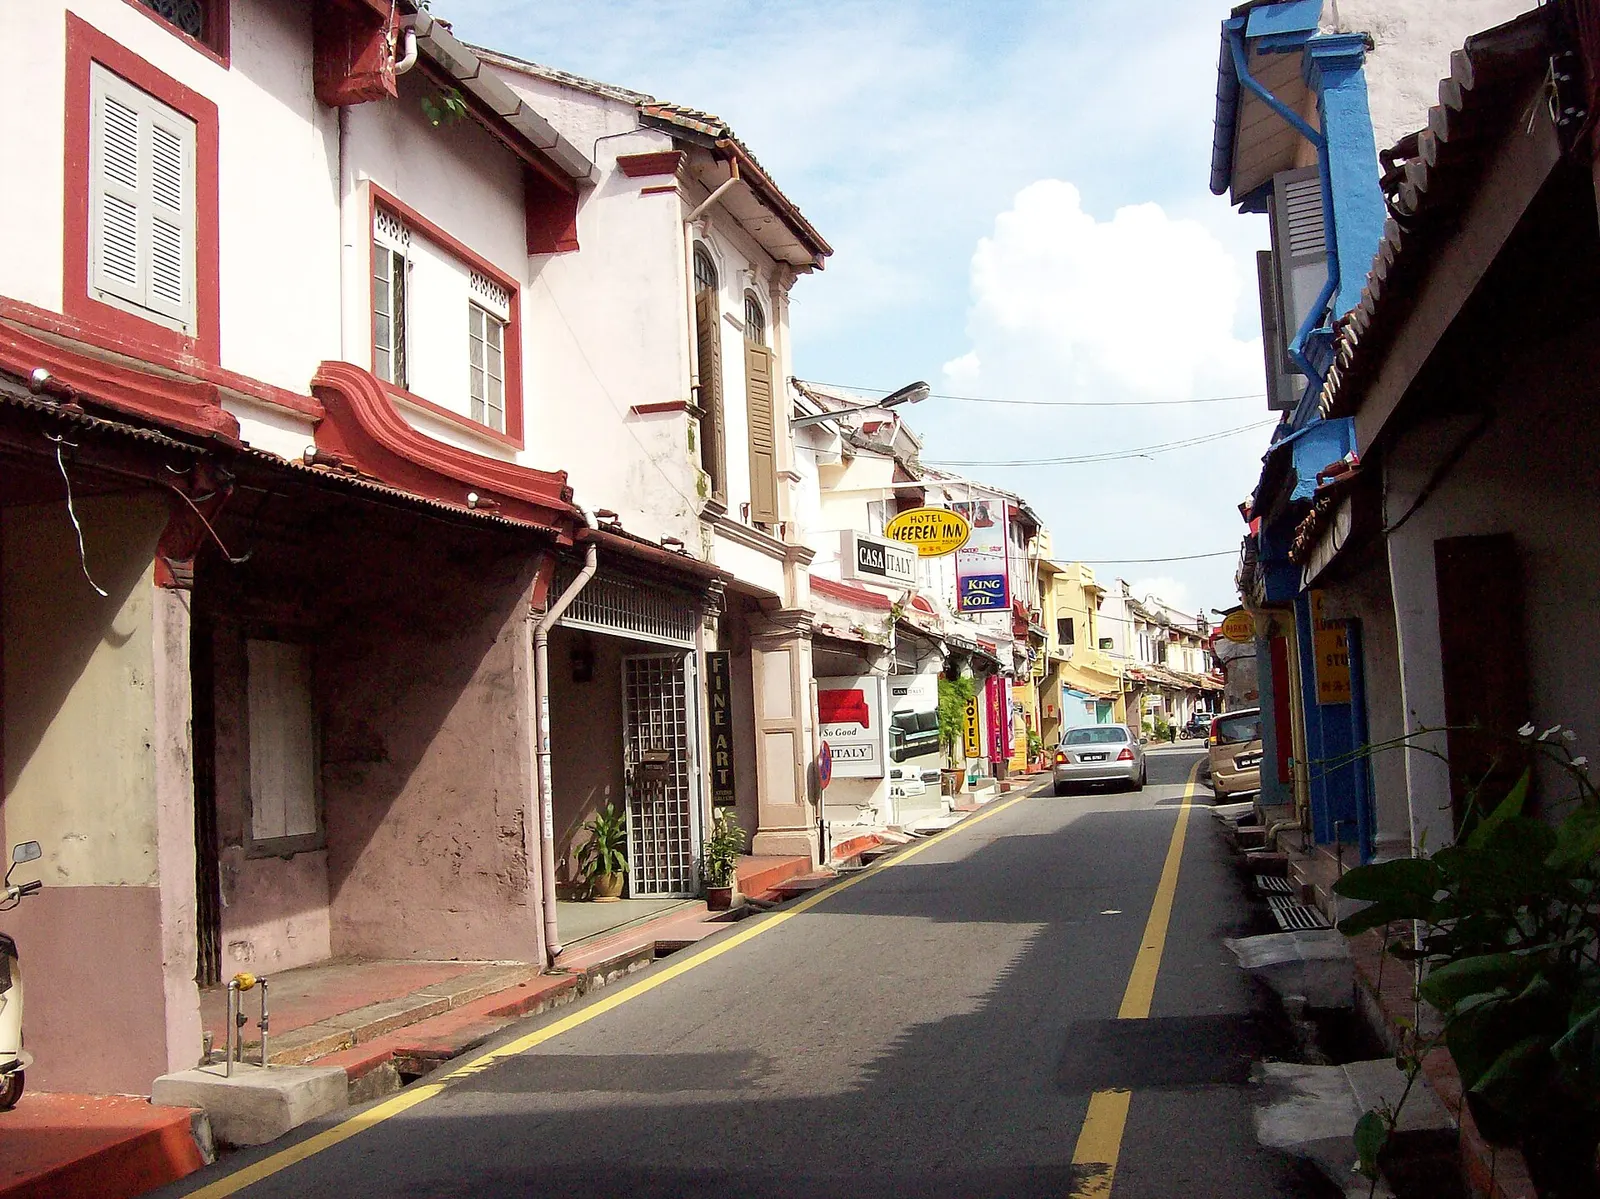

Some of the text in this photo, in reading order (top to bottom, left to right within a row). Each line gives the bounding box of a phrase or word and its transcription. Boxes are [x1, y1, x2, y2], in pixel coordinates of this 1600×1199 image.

[910, 514, 943, 524] HOTEL
[893, 524, 963, 540] HEEREN INN
[859, 547, 911, 574] CASA ITALY
[968, 580, 1001, 589] KING
[963, 596, 993, 606] KOIL
[713, 658, 728, 785] FINE ART
[966, 698, 975, 748] HOTEL
[823, 728, 857, 737] So Good
[831, 748, 867, 758] ITALY
